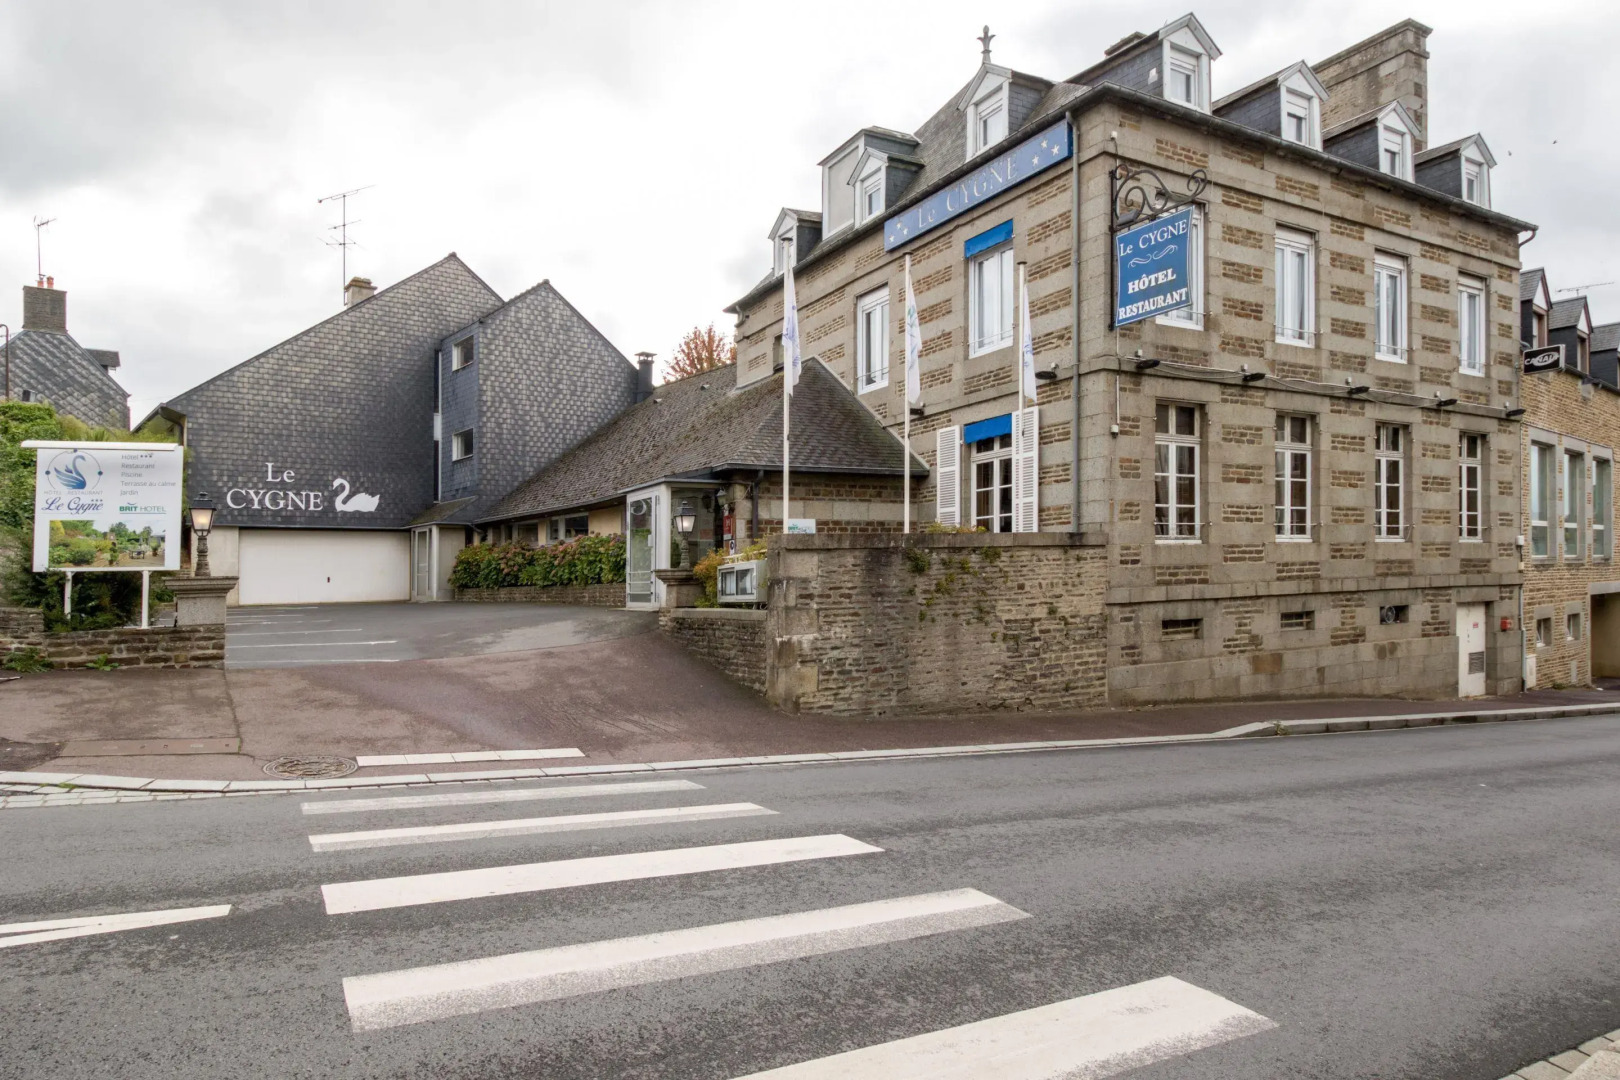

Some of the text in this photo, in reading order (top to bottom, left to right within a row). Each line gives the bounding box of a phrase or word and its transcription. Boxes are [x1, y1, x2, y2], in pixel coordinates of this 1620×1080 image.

[918, 153, 1018, 228] Le CYGNE
[1120, 219, 1188, 257] Le CYGNE
[1127, 268, 1177, 294] HÔTEL
[1118, 287, 1189, 320] RESTAURANT
[265, 462, 295, 482] Le
[41, 496, 104, 515] Le Cygne
[226, 488, 323, 511] CYGNE
